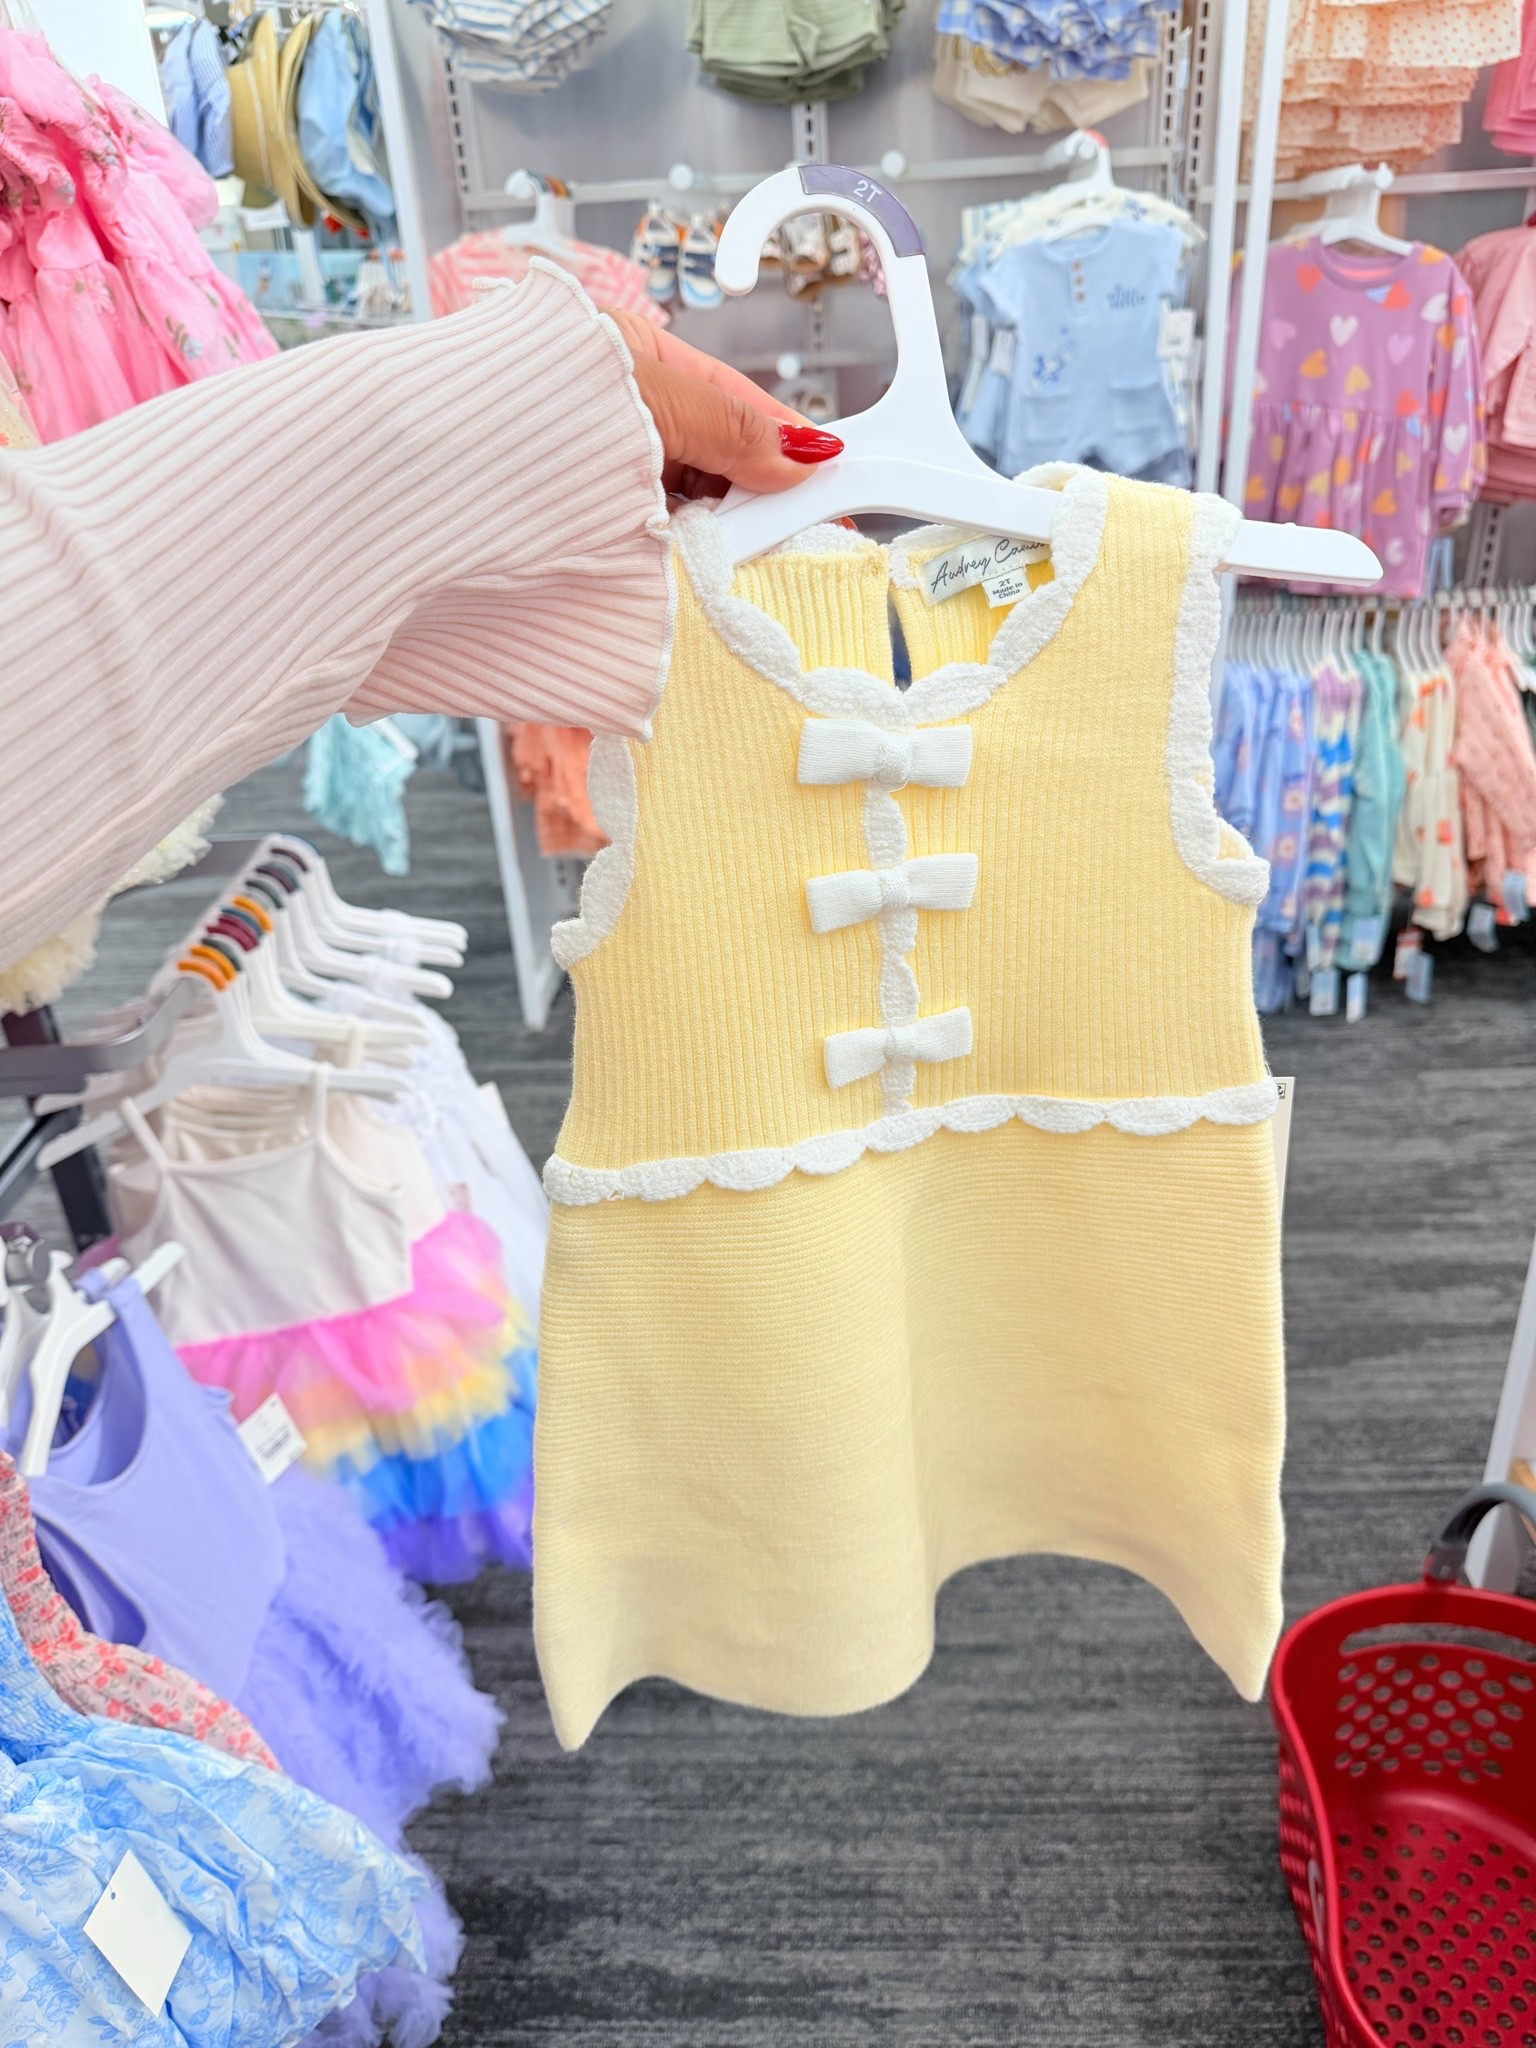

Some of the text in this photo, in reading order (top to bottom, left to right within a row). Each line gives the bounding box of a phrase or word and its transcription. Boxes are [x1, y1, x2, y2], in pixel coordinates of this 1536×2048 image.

[852, 179, 882, 203] 2T
[930, 555, 992, 594] Audrey
[998, 578, 1010, 587] 2T
[992, 585, 1013, 595] Made
[998, 589, 1020, 599] China
